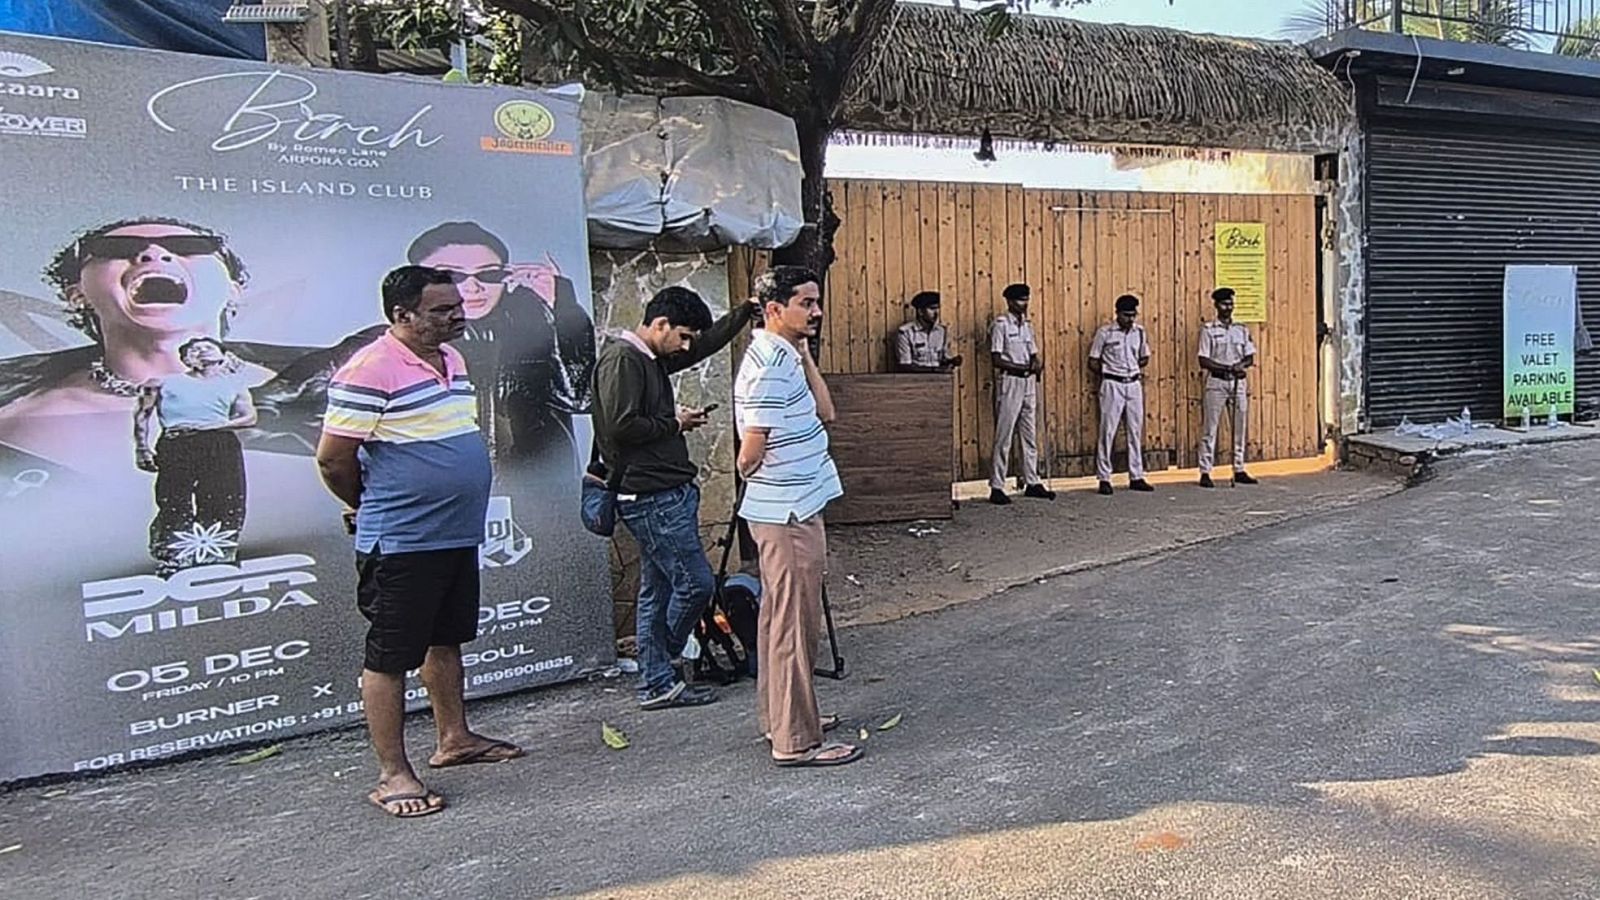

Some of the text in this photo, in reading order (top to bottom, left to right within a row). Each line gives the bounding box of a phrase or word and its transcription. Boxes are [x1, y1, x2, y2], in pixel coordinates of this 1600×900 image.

[147, 70, 444, 150] Birch
[278, 154, 380, 168] ARPORA GOA
[352, 147, 388, 157] Lane
[174, 175, 433, 199] THE ISLAND CLUB
[1525, 332, 1556, 347] FREE
[1521, 352, 1560, 367] VALET
[1513, 371, 1567, 387] PARKING
[1507, 390, 1572, 408] AVAILABLE
[86, 589, 319, 643] MILDA
[500, 621, 518, 633] 10
[519, 617, 543, 628] PM
[107, 639, 311, 692] 05 DEC
[142, 680, 212, 701] FRIDAY
[230, 673, 251, 684] 10
[255, 667, 285, 679] PM
[73, 753, 124, 772] FOR
[130, 714, 297, 761] RESERVATIONS
[472, 655, 574, 686] 8595908825
[130, 694, 280, 736] BURNER
